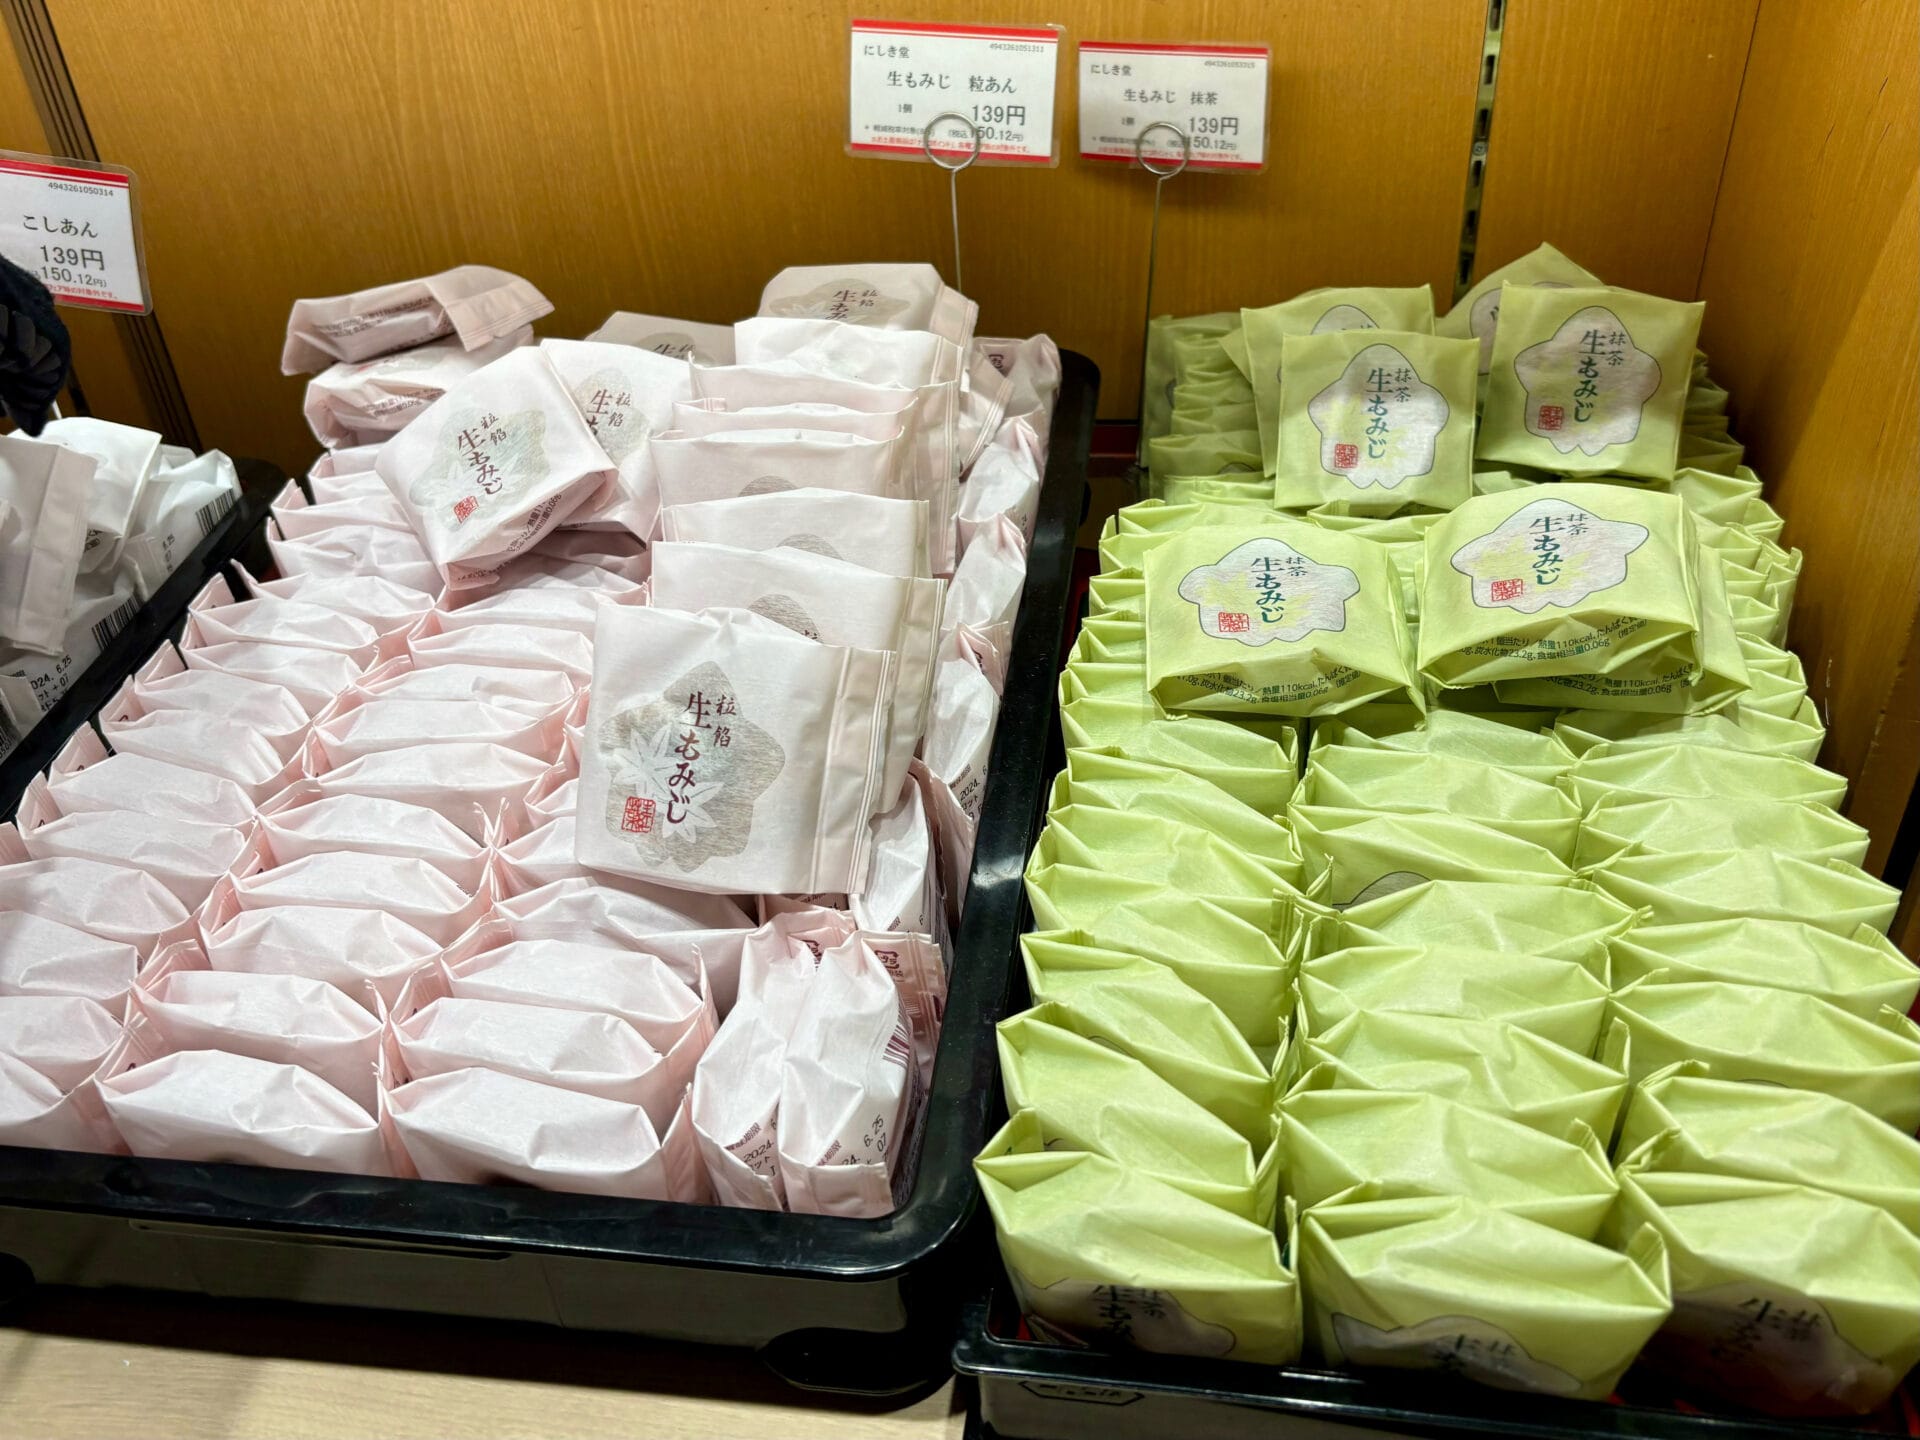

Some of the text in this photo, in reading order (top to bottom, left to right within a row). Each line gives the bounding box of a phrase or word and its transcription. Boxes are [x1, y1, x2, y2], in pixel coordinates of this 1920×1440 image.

[863, 45, 910, 58] にしき堂
[887, 71, 1017, 94] 生もみじ 粒あん
[1090, 64, 1132, 76] にしき堂
[1124, 89, 1218, 106] 生もみじ 抹茶
[972, 105, 1026, 126] 139円
[1189, 117, 1239, 136] 139円
[48, 182, 114, 197] 4943261050314
[23, 214, 98, 239] こしあん
[40, 245, 105, 271] 139円
[1605, 331, 1627, 367] 抹茶
[1394, 368, 1413, 403] 抹茶
[1573, 329, 1607, 423] 生もみじ
[1364, 368, 1394, 459] 生もみじ
[480, 412, 507, 446] 粒餡
[457, 427, 503, 495] 生もみじ
[1565, 513, 1590, 536] 抹茶
[1529, 516, 1565, 586] 生もみじ
[1285, 556, 1309, 577] 抹茶
[1250, 556, 1287, 624] 生もみじ
[56, 654, 72, 674] 6.25
[713, 694, 737, 748] 粒餡
[666, 691, 713, 824] 生もみじ
